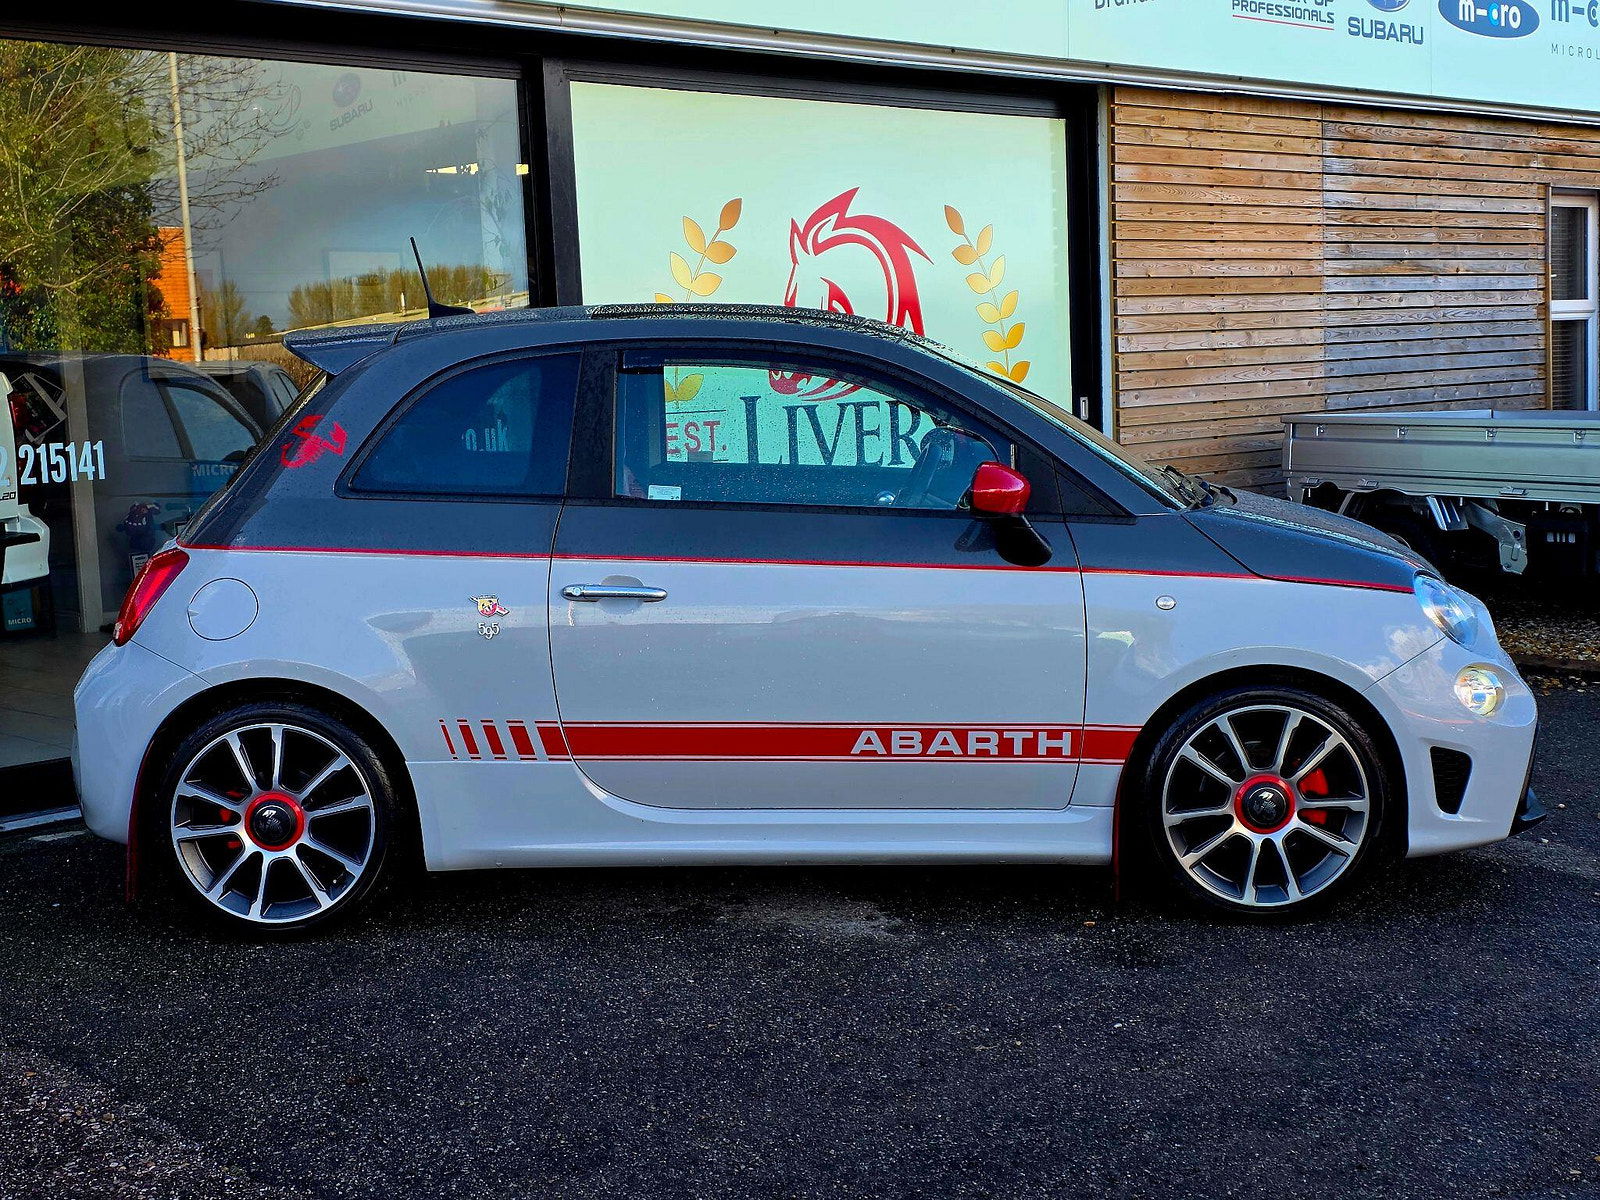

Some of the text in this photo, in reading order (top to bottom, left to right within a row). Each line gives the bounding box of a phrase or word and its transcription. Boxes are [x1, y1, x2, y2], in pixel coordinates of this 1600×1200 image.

[1232, 0, 1334, 24] PROFESSIONALS
[1347, 16, 1424, 45] SUBARU
[329, 99, 374, 132] SUBARU
[18, 440, 105, 485] 215141
[8, 617, 32, 625] MICRO
[478, 622, 500, 640] 595
[850, 730, 1072, 756] ABARTH
